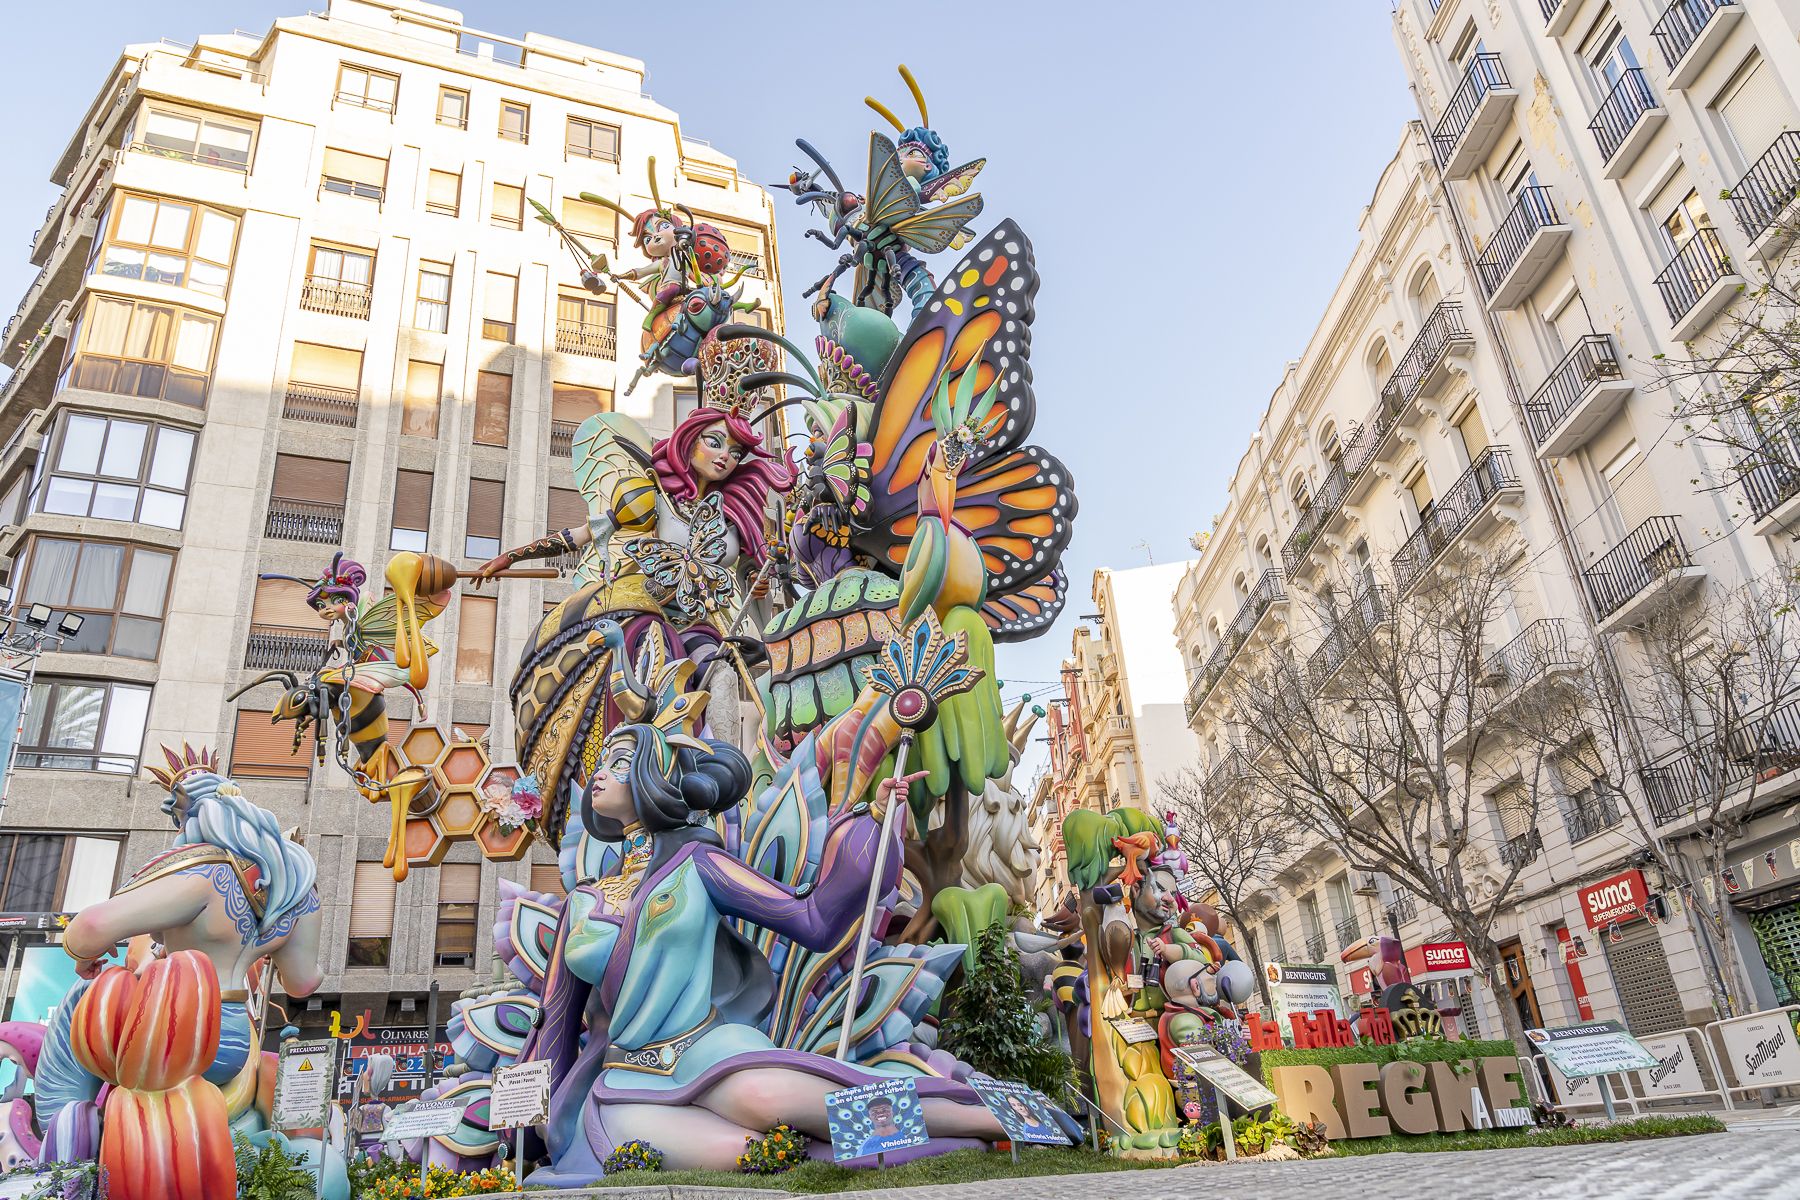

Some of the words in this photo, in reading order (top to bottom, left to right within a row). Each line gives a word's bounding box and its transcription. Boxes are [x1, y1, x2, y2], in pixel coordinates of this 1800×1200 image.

[1593, 902, 1637, 923] SUPERMERCADOS
[1284, 970, 1327, 981] BENVINGUTS
[381, 1030, 429, 1040] OLIVARES
[1245, 1012, 1284, 1052] La
[1288, 1009, 1355, 1049] Falla
[1553, 1025, 1610, 1038] BENVINGUTS
[289, 1046, 327, 1054] PRECAUCIONS
[360, 1044, 449, 1057] ALQUILAO
[834, 1087, 862, 1098] Sempre
[862, 1082, 878, 1091] fent
[886, 1079, 904, 1087] pavo
[853, 1093, 873, 1101] camp
[1272, 1056, 1522, 1139] REGNE
[880, 1137, 912, 1148] Vinicius
